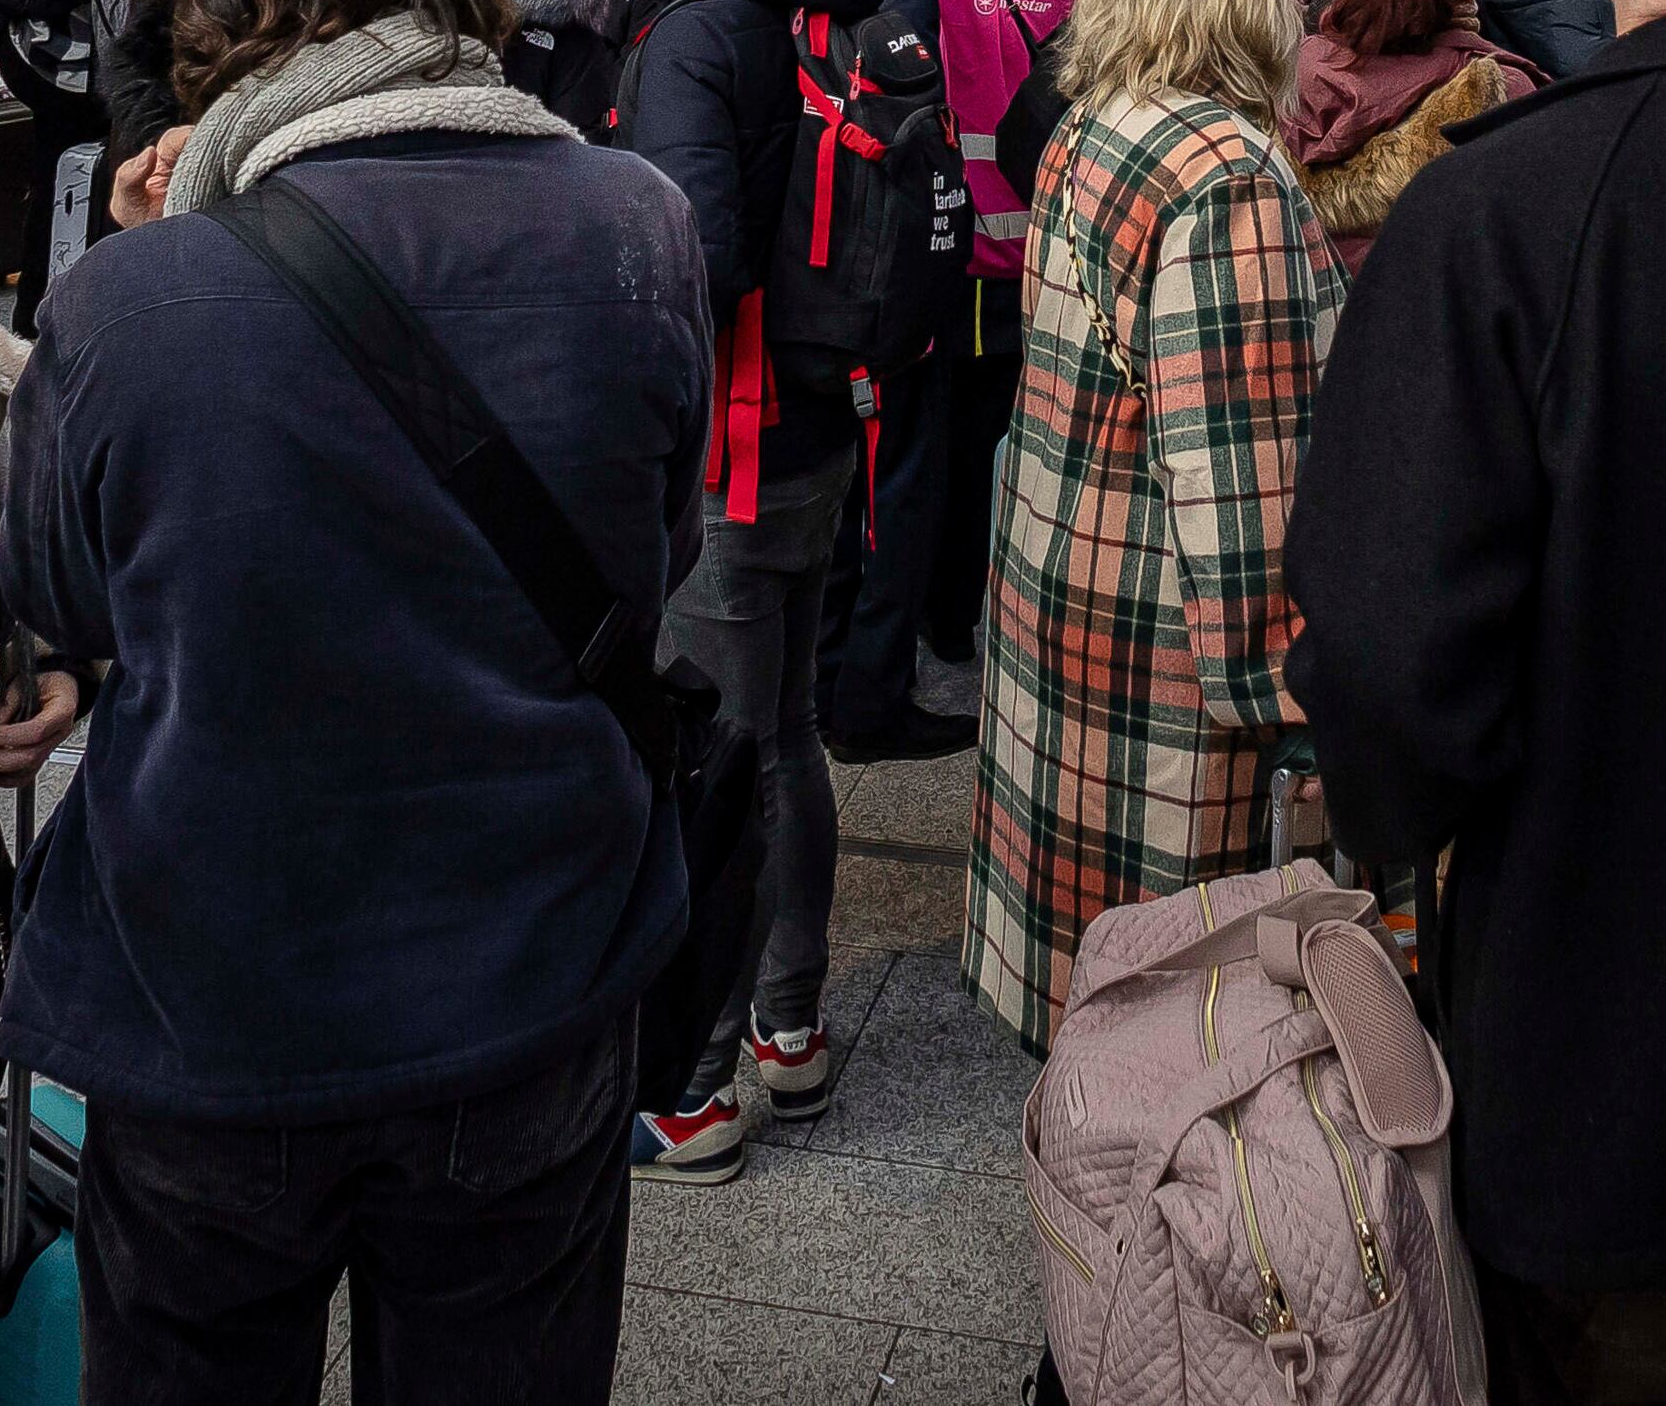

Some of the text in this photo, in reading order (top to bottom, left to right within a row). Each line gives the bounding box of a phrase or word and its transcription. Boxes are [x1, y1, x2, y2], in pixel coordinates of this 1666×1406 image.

[933, 171, 944, 190] in
[933, 215, 949, 231] we
[930, 231, 955, 251] trust
